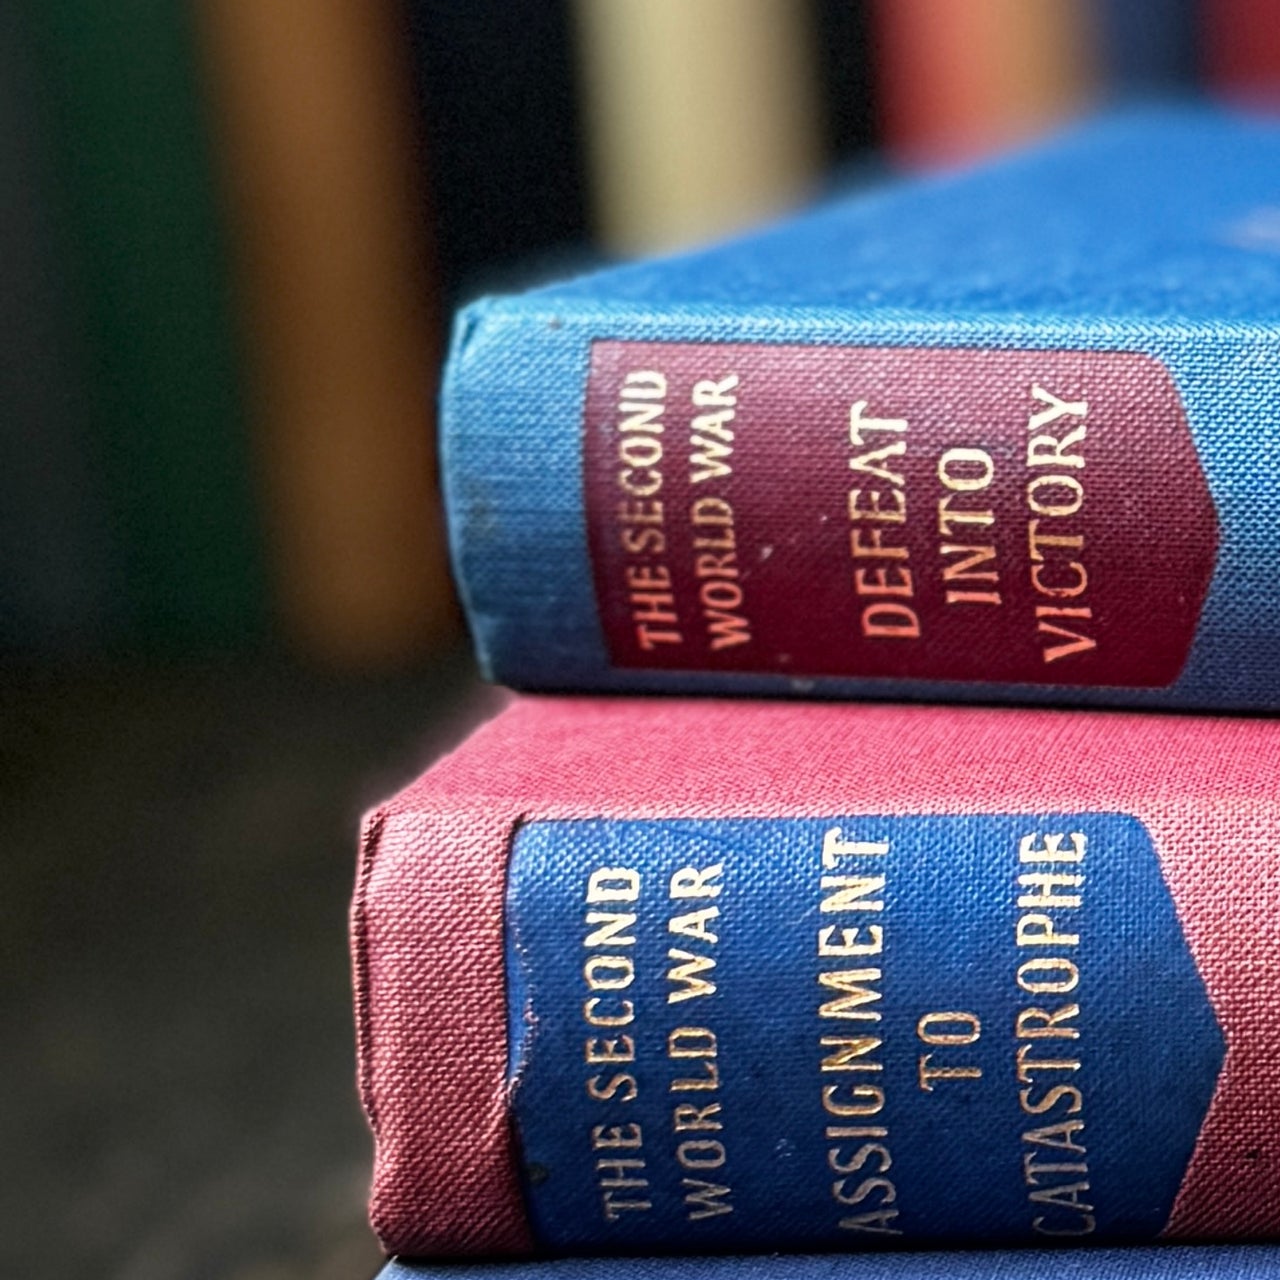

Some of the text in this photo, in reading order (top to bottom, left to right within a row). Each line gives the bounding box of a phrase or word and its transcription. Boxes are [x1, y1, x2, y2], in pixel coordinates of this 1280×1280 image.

[618, 371, 683, 650] THE SECOND
[689, 374, 751, 651] WORLD WAR
[849, 400, 920, 638] DEFEAT
[939, 448, 1001, 604] INTO
[1027, 384, 1097, 663] VICTORY
[584, 867, 652, 1219] THE SECOND
[667, 862, 734, 1220] WORLD WAR
[818, 826, 903, 1236] ASSIGNMENT
[916, 1010, 982, 1092] TO
[1016, 831, 1096, 1236] CATASTROPHE
